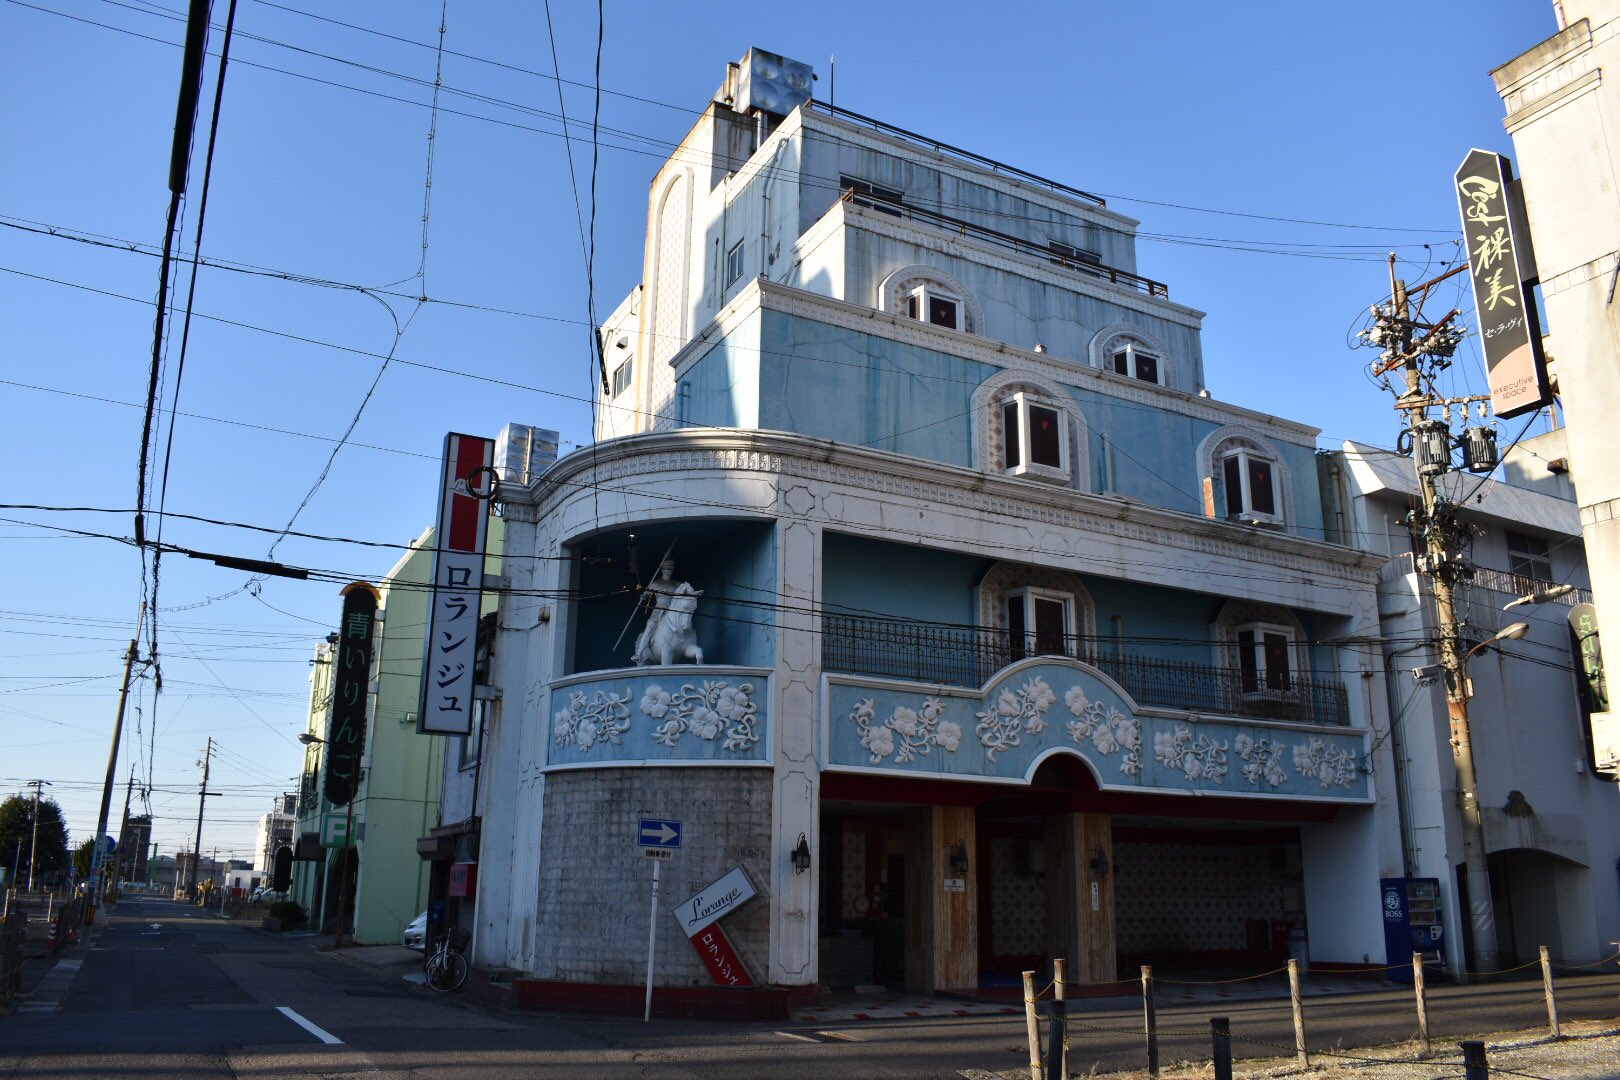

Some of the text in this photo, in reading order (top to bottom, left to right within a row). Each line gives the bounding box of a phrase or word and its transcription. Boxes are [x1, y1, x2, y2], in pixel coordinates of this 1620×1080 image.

[1493, 375, 1534, 395] executive
[1502, 386, 1527, 399] space
[437, 565, 472, 712] ロランジュ
[327, 818, 353, 843] P
[688, 888, 742, 927] L'orange
[1385, 910, 1402, 918] BOSS
[702, 933, 739, 985] ロランジュ
